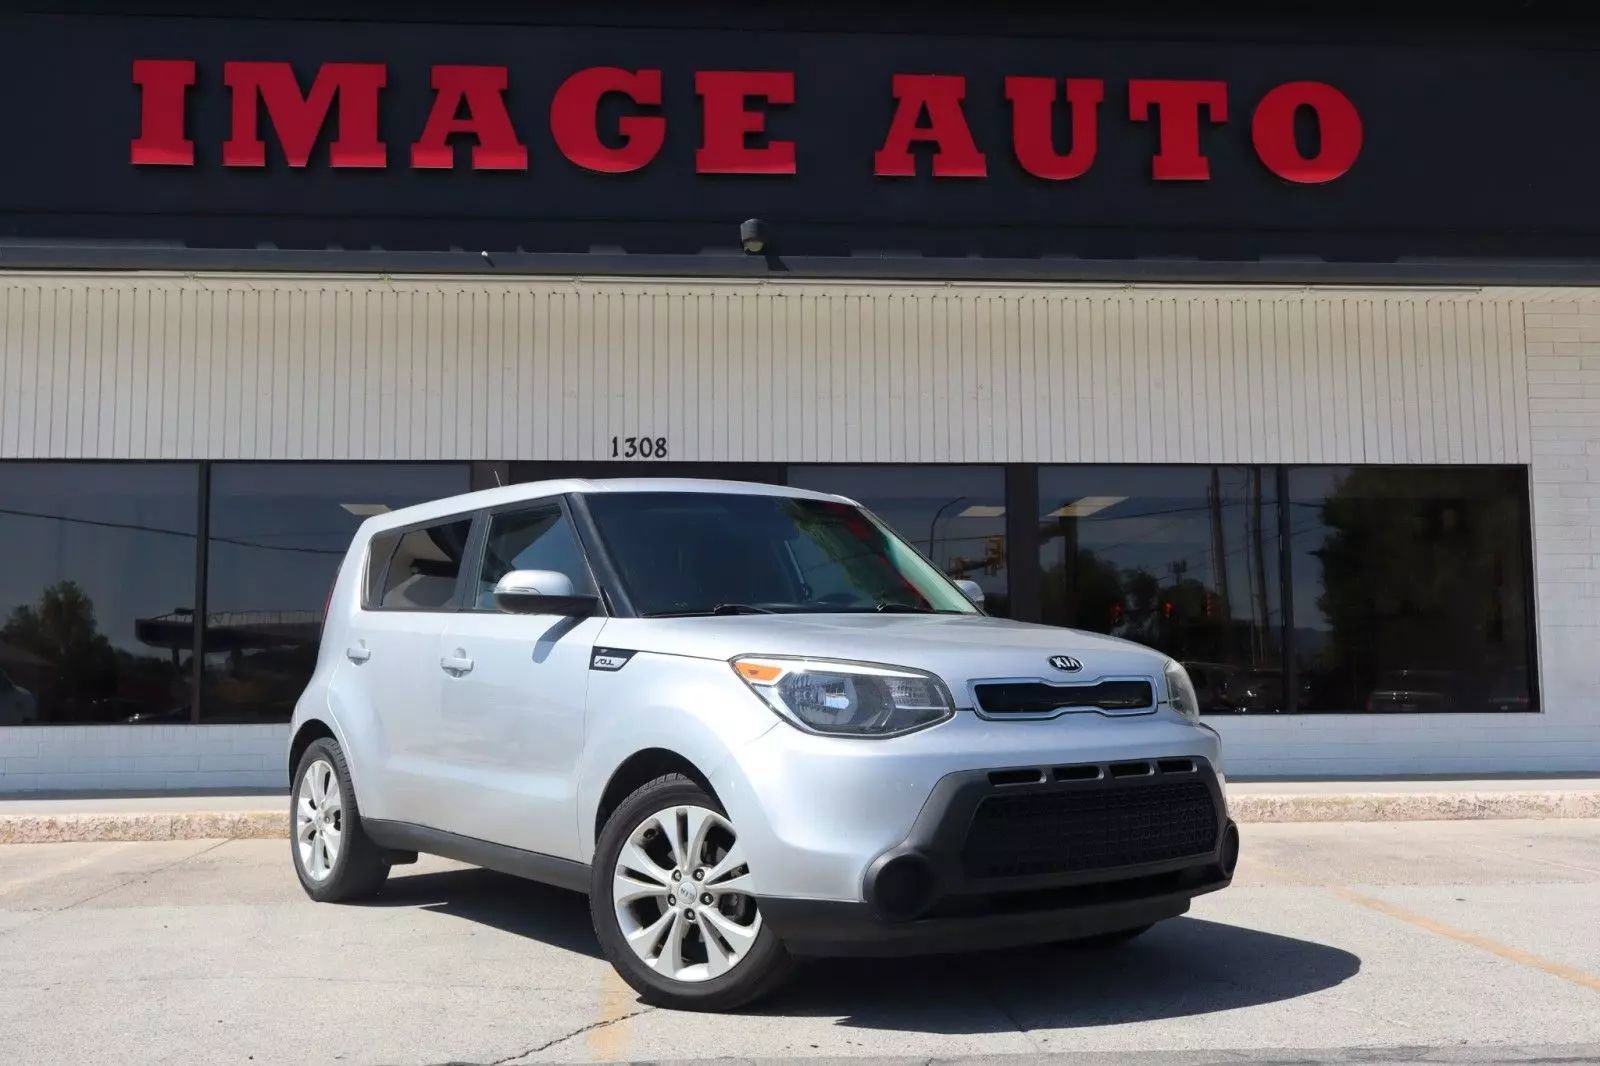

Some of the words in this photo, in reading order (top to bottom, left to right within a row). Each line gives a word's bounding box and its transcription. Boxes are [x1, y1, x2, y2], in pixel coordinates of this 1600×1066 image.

[130, 58, 797, 174] IMAGE
[874, 74, 1363, 184] AUTO
[611, 436, 667, 458] 1308
[1052, 656, 1080, 668] KIA
